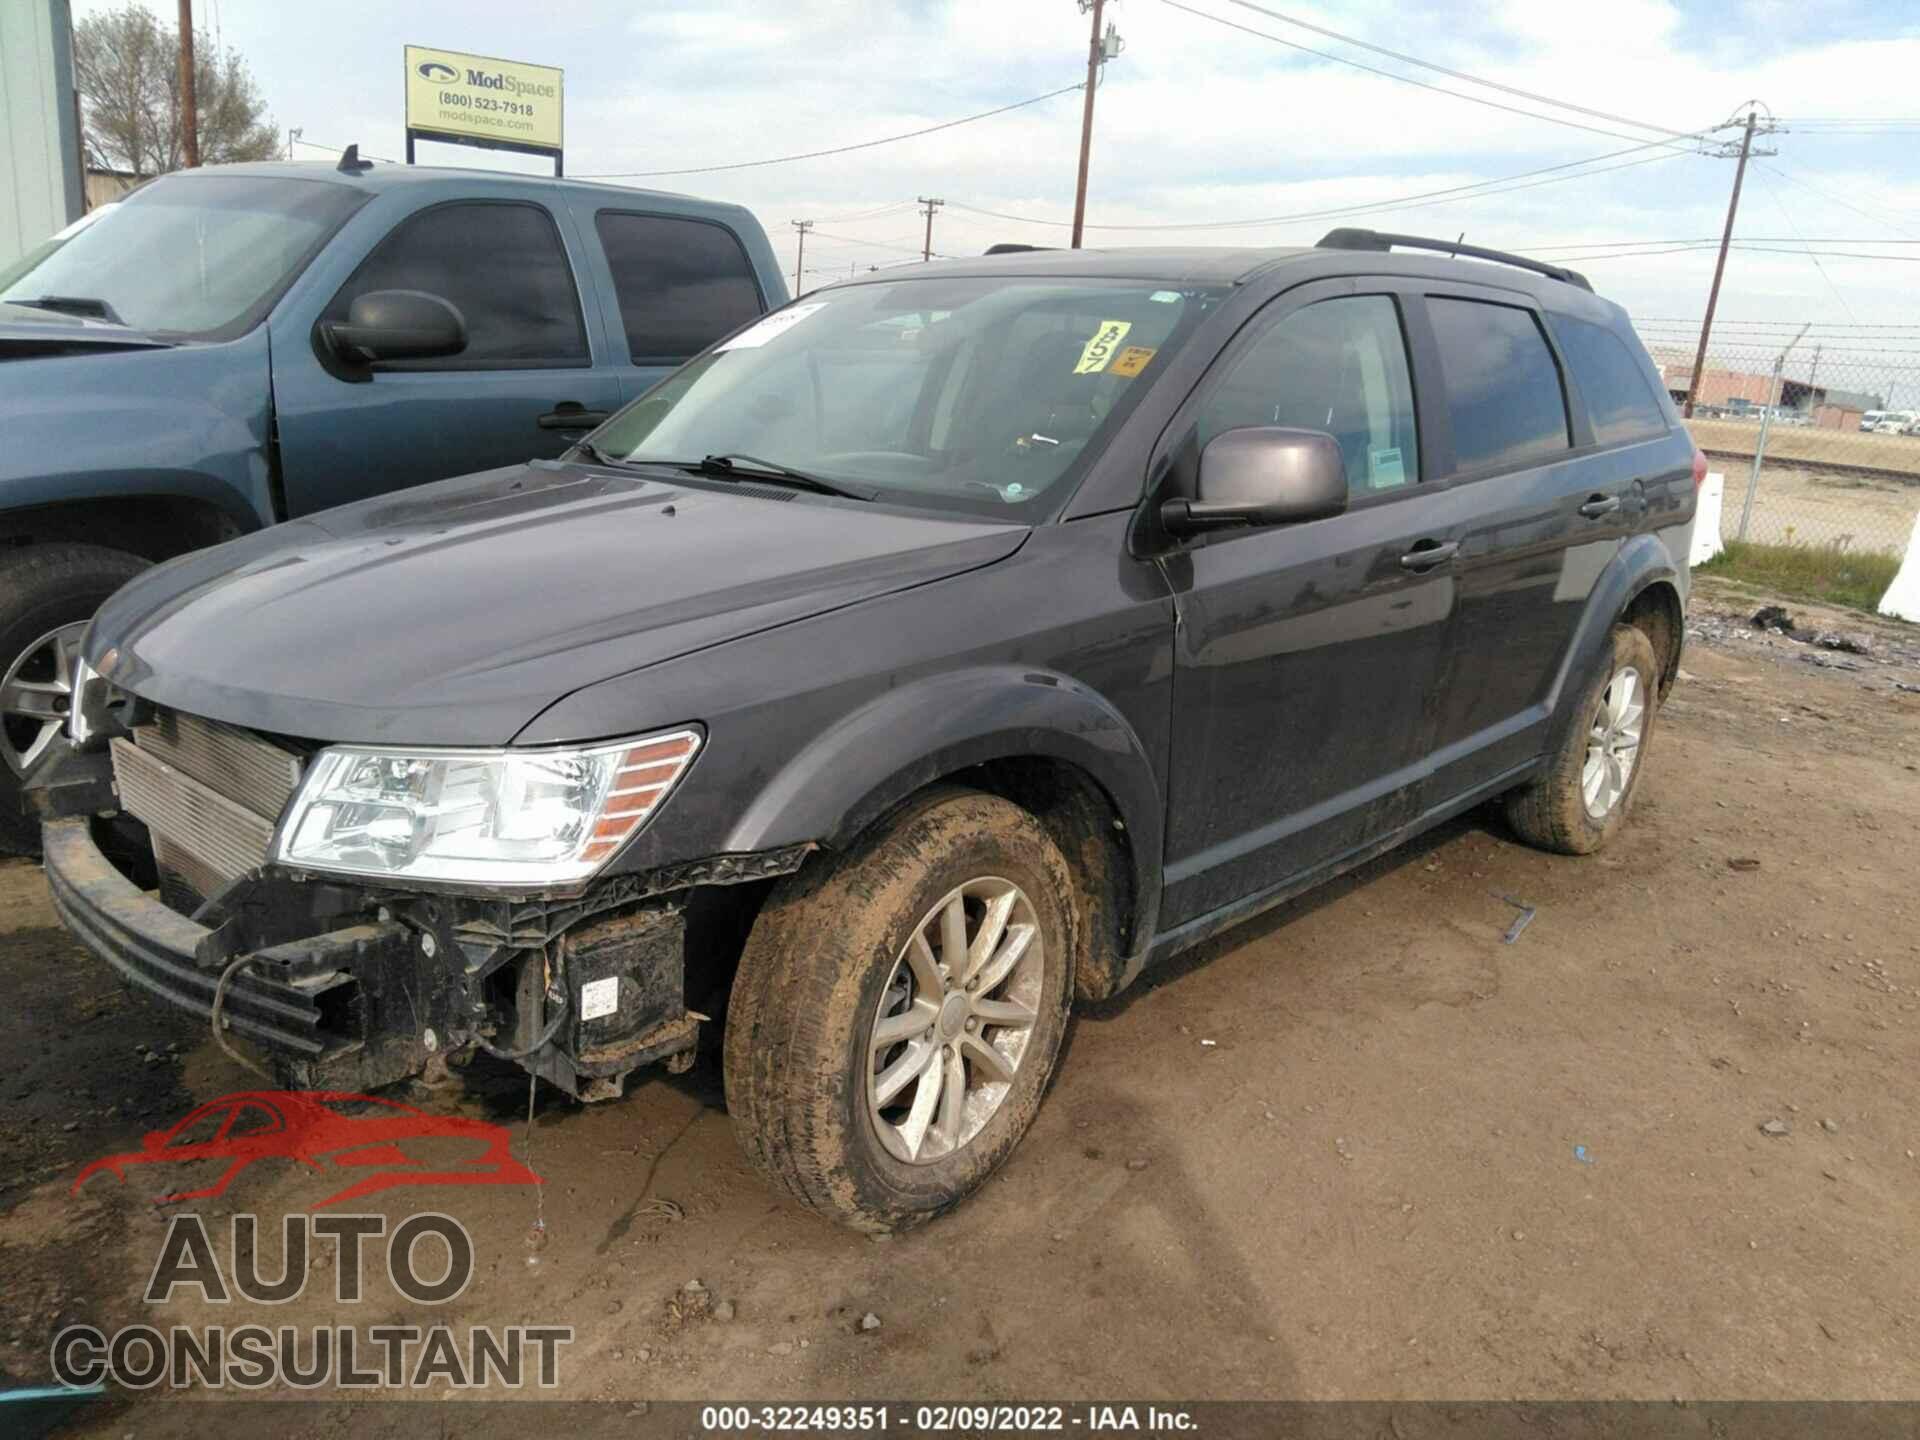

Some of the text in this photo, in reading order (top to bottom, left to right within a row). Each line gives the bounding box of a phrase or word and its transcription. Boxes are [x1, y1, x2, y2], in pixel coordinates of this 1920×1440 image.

[467, 69, 554, 97] ModSpace
[439, 90, 534, 116] (800) 523-7918
[439, 109, 534, 131] modspace.com
